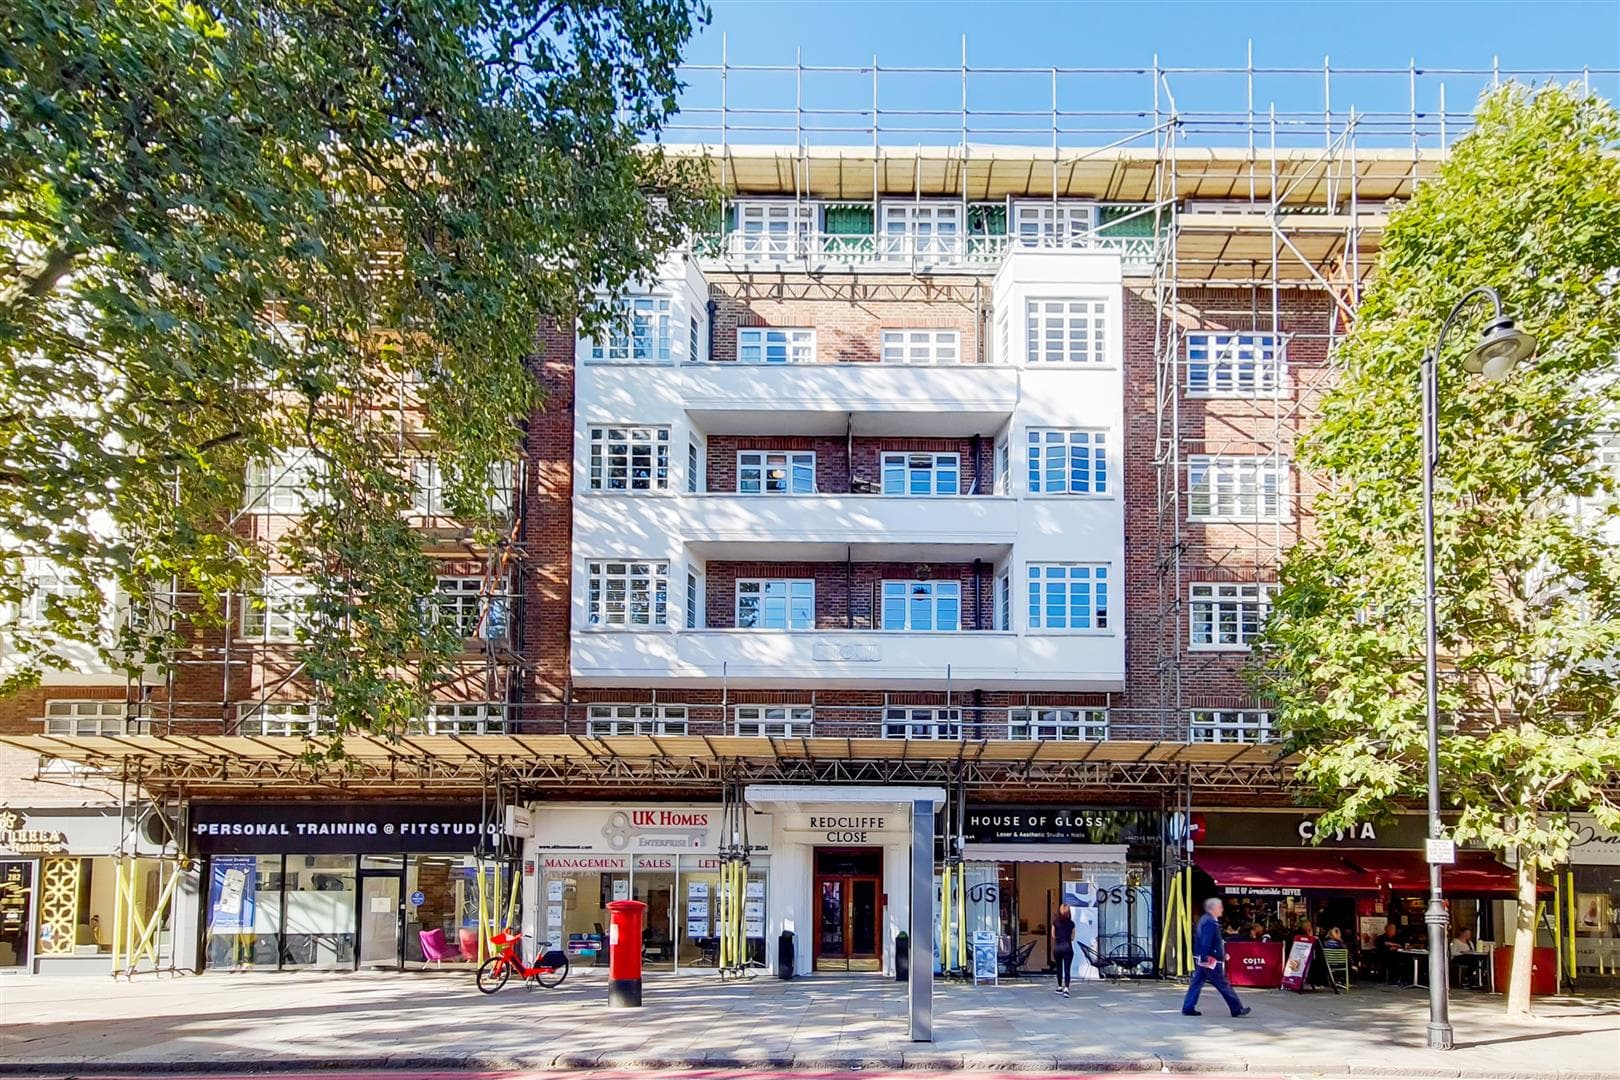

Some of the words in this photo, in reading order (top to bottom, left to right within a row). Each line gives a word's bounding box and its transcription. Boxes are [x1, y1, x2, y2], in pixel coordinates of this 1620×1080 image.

[632, 811, 657, 826] UK
[810, 817, 884, 828] REDCLIFFE
[971, 815, 1020, 826] HOUSE
[1028, 816, 1047, 826] OF
[1055, 817, 1102, 827] GLOSS
[197, 823, 289, 835] PERSONAL
[297, 823, 377, 835] TRAINING
[383, 823, 394, 834] @
[827, 831, 867, 842] CLOSE
[43, 842, 60, 854] Spa
[638, 838, 686, 848] ENTERPRISE
[544, 859, 625, 868] MANAGEMENT
[638, 860, 671, 868] SALES
